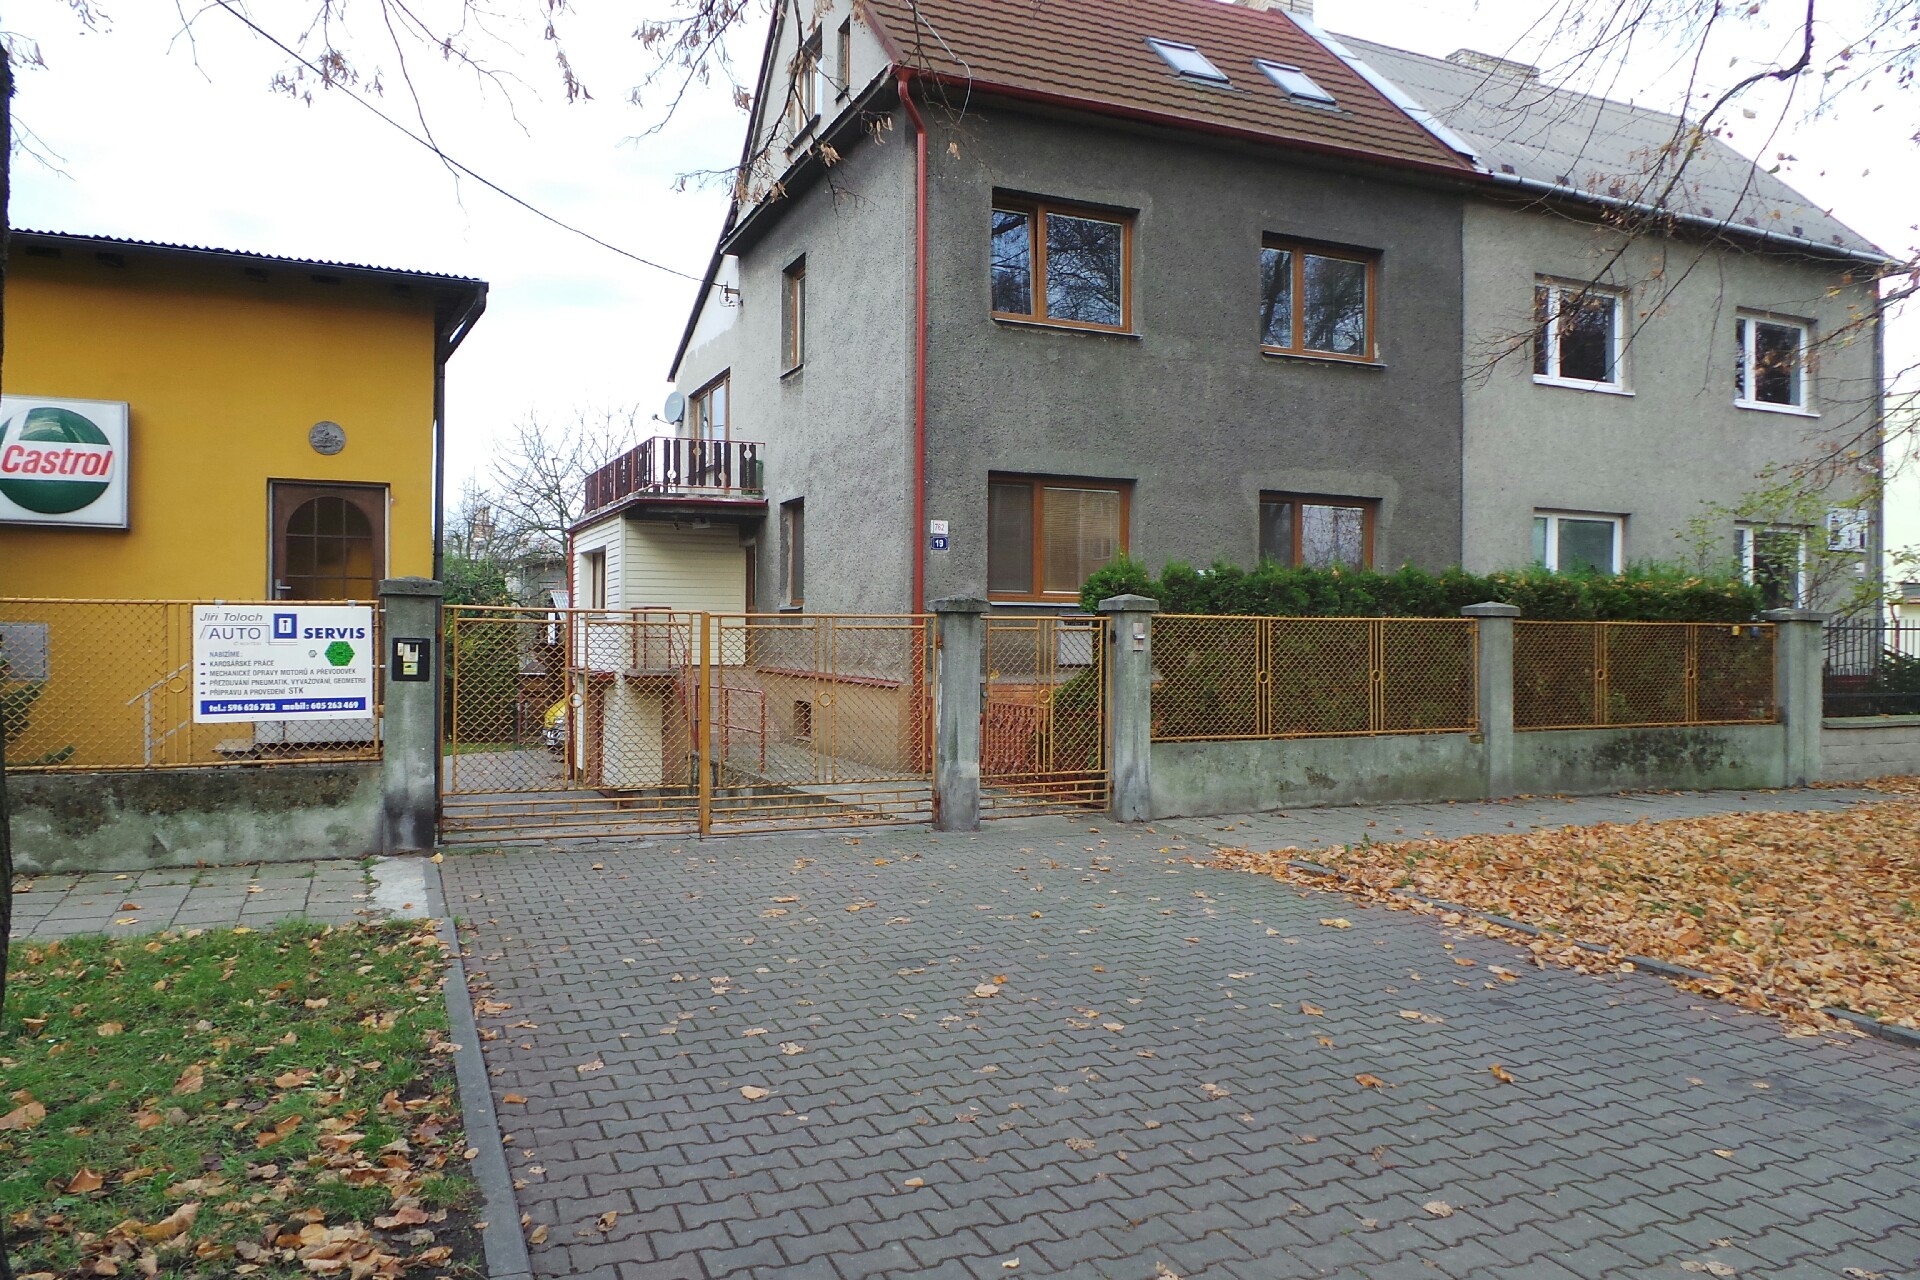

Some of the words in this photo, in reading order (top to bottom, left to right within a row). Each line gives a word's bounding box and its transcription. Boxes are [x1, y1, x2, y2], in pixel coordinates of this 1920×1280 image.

[1, 444, 113, 476] Castrol
[935, 539, 944, 548] 19
[200, 612, 219, 622] Jiří
[224, 612, 263, 622] Toloch
[208, 627, 261, 640] AUTO
[303, 627, 366, 640] SERVIS
[288, 686, 304, 694] STK
[227, 703, 243, 712] 596
[243, 703, 259, 711] 626
[259, 703, 276, 711] 783
[282, 702, 310, 711] mobil:
[310, 702, 327, 710] 605
[327, 702, 343, 710] 263
[343, 701, 359, 709] 469
